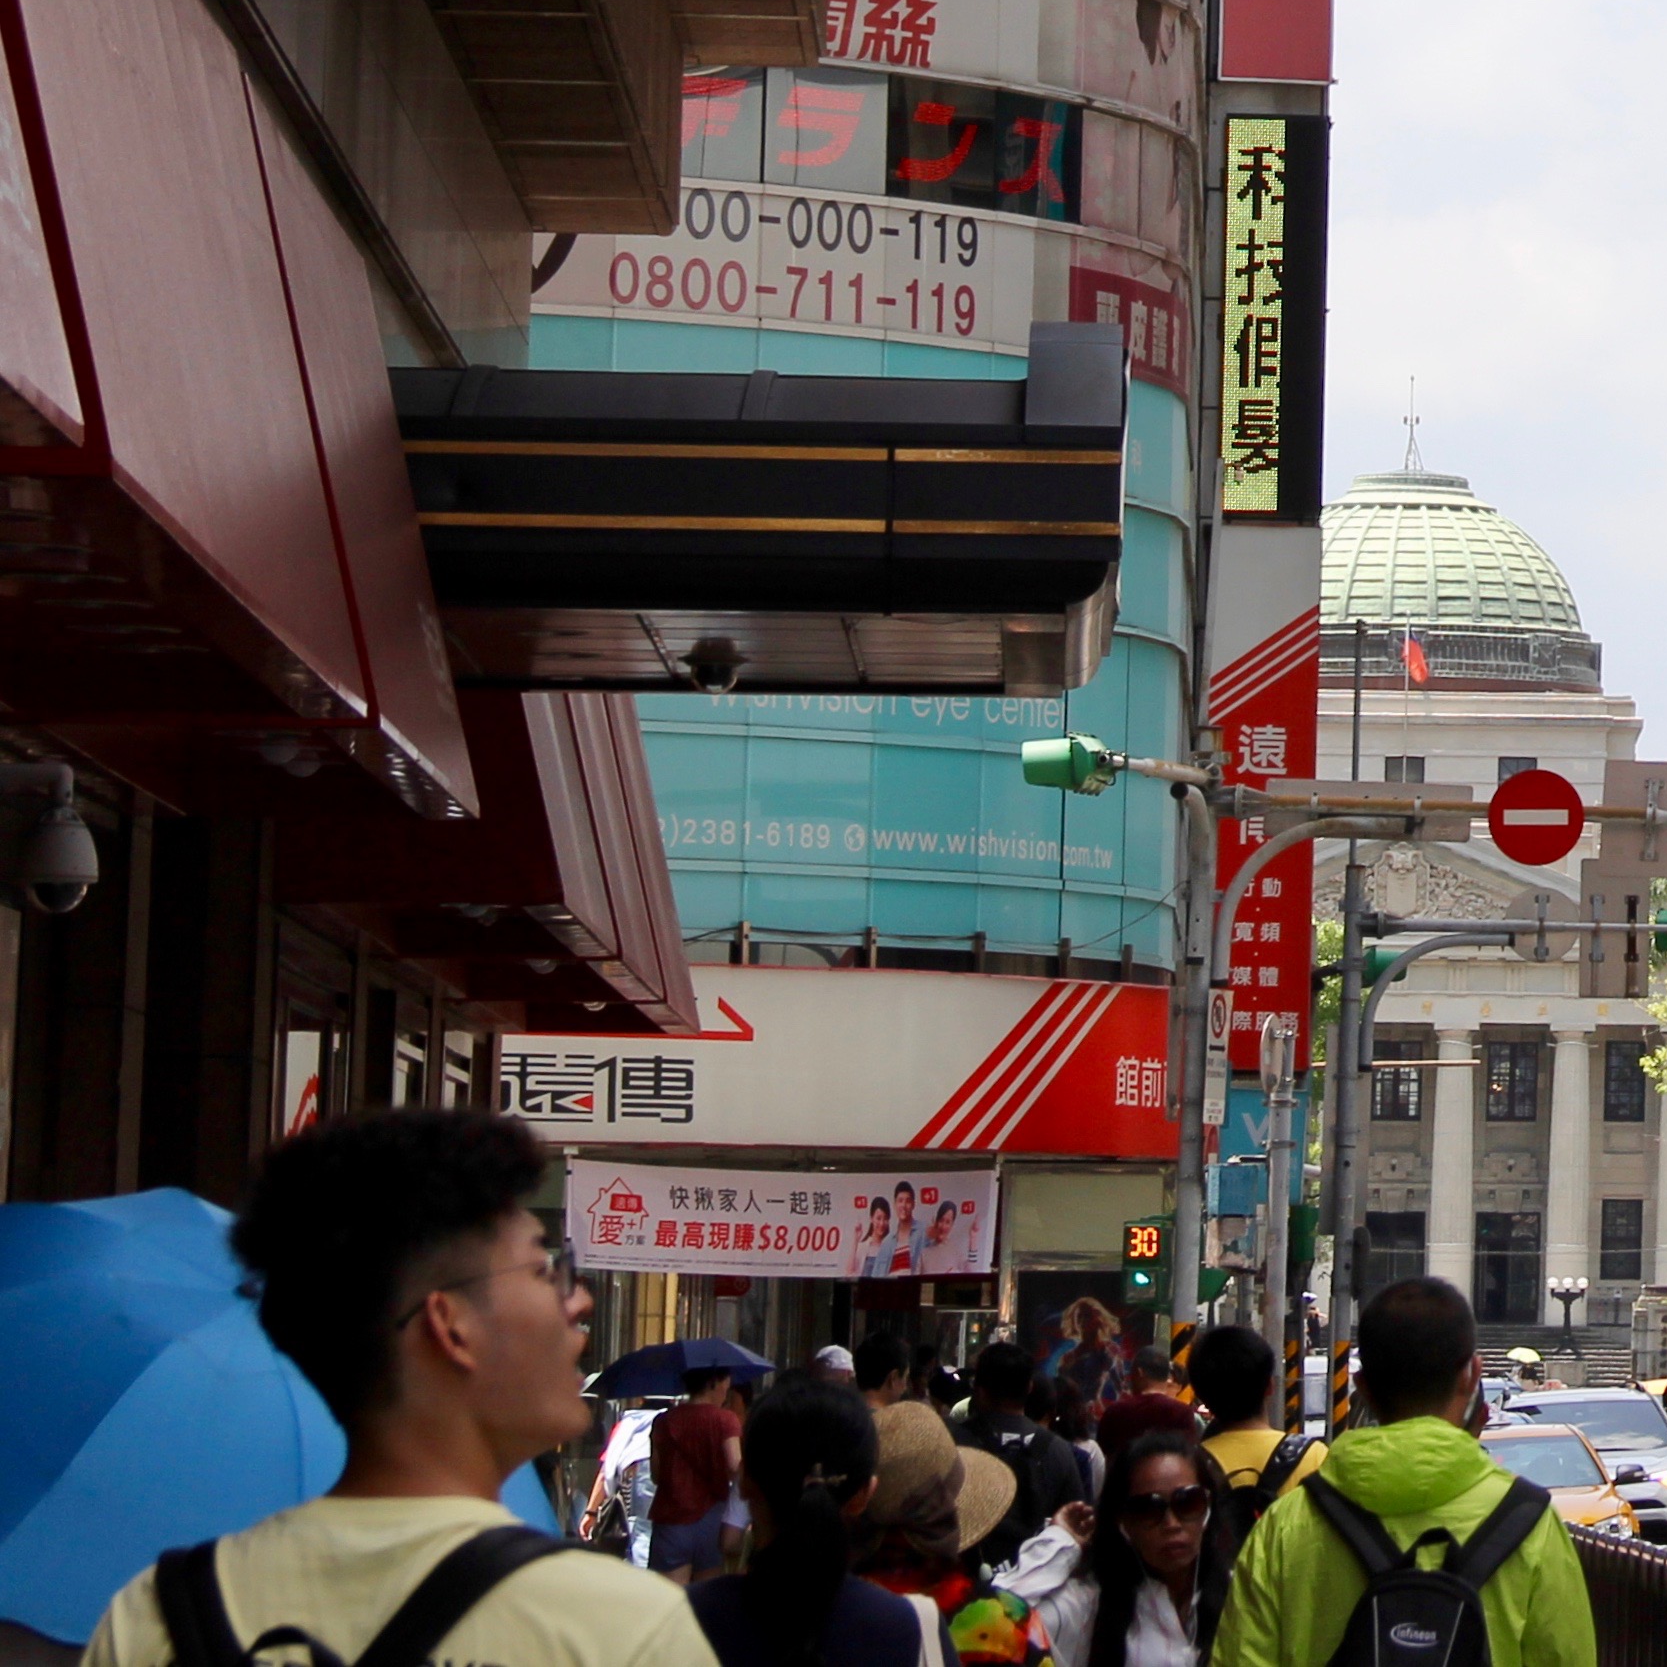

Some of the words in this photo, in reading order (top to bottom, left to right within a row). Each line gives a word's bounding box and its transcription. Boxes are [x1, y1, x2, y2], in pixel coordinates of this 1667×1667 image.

[609, 251, 977, 337] 0800-711-119
[873, 827, 1114, 871] www.wishvision.com.tw
[1234, 921, 1281, 944] 寬頻
[1231, 966, 1280, 988] 媒體
[1115, 1055, 1168, 1109] 館前
[670, 1185, 832, 1215] 快揪家人一起辦
[654, 1221, 841, 1253] 最高現賺$8,000
[1128, 1227, 1158, 1258] 30
